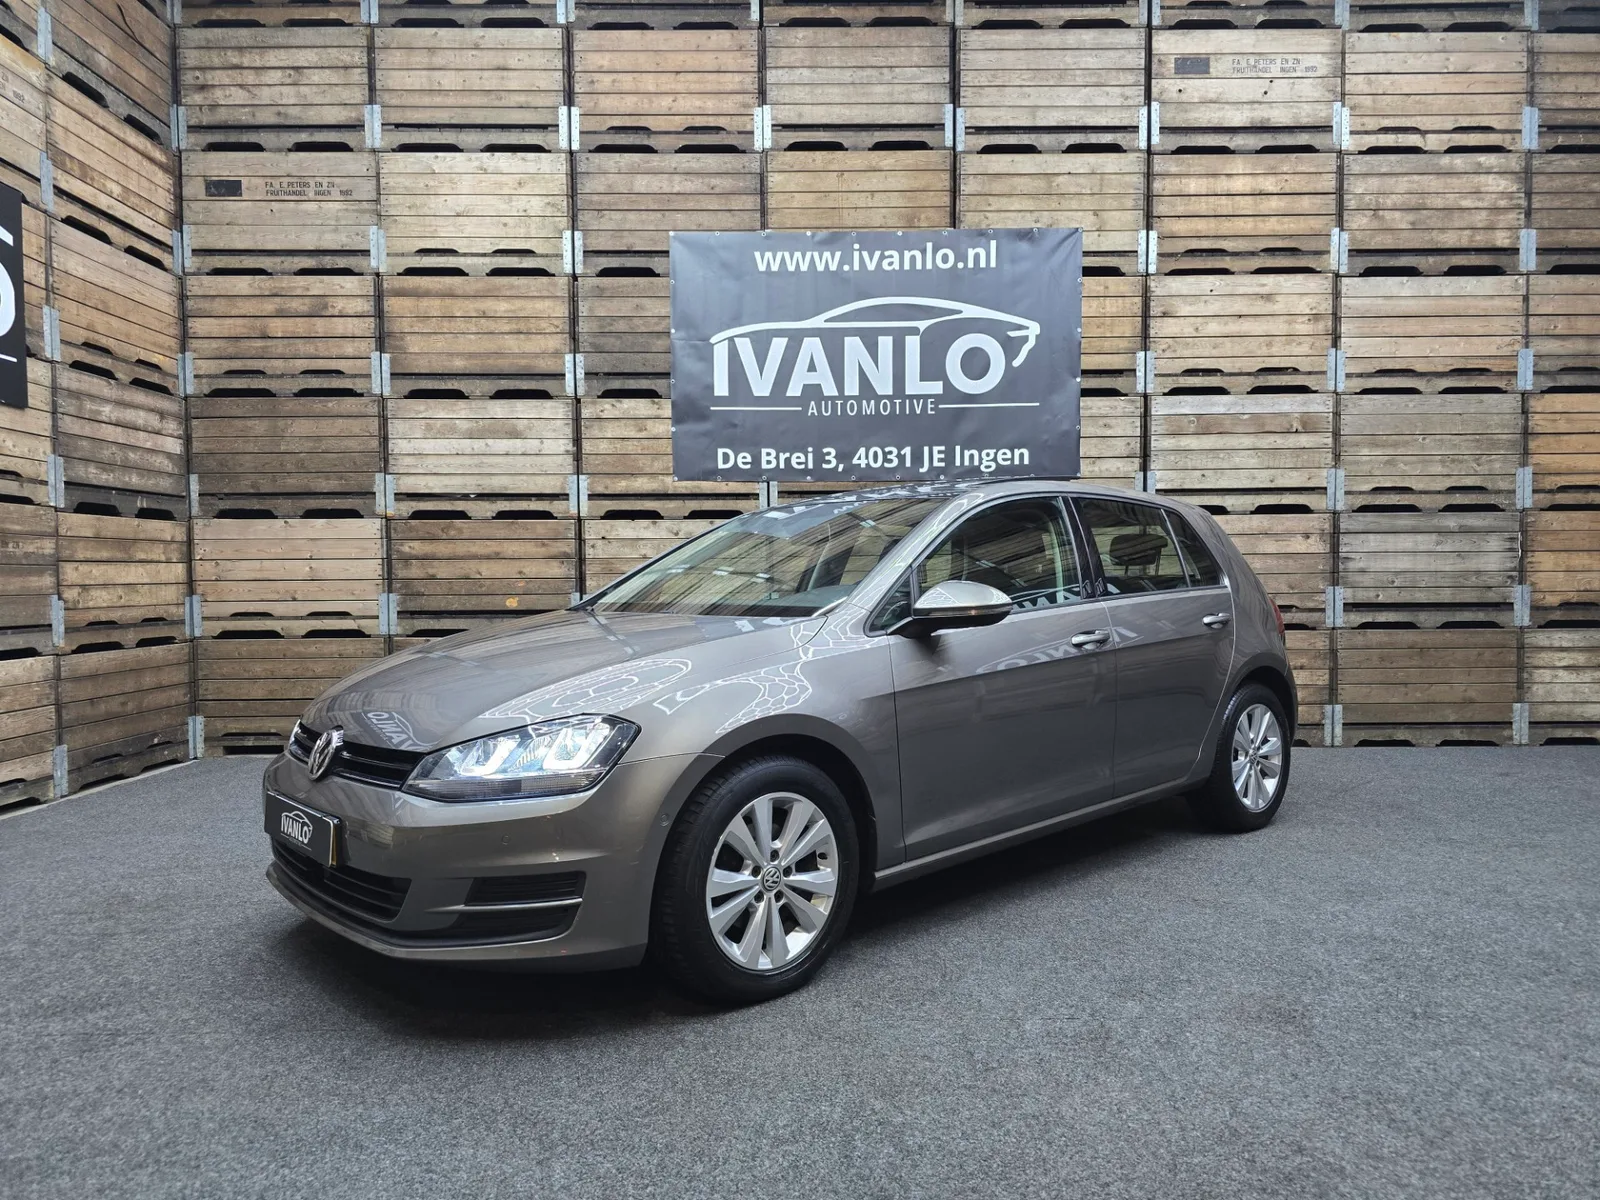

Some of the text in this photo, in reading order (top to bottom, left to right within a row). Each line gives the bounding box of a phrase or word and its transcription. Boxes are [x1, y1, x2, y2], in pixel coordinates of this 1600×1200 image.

[753, 239, 997, 272] www.ivanlo.nl
[713, 333, 1006, 397] IVANLO
[807, 399, 936, 416] AUTOMOTIVE
[717, 445, 1030, 473] De Brei 3, 4031 JE Ingen
[281, 815, 310, 844] IVANLO
